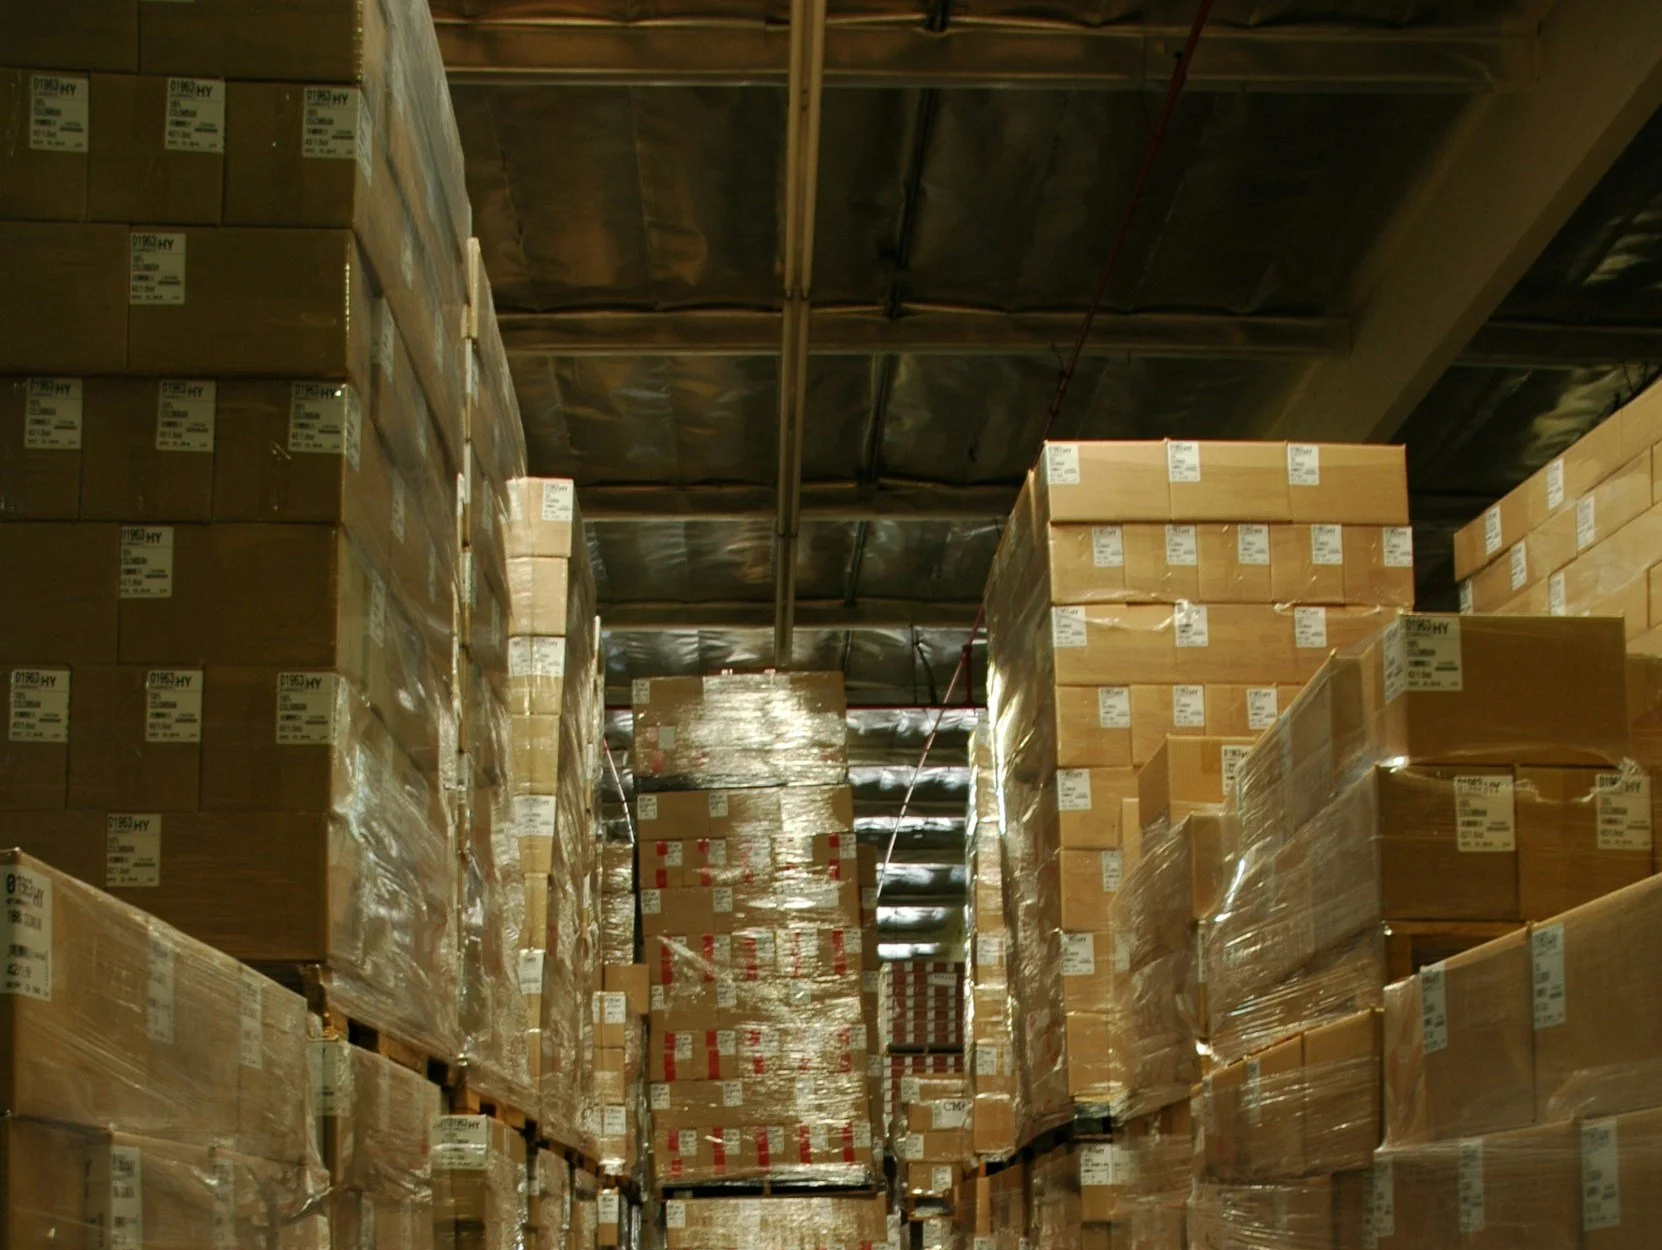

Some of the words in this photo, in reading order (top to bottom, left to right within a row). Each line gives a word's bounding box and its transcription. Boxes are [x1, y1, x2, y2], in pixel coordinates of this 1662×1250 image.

[60, 83, 77, 95] HY
[196, 86, 213, 97] HY
[332, 94, 350, 105] HY
[158, 239, 175, 250] HY
[55, 383, 72, 396] HY
[188, 386, 204, 398] HY
[145, 533, 162, 545] HY
[1433, 623, 1450, 635] HY
[15, 671, 40, 684] 01963
[41, 676, 57, 688] HY
[150, 672, 174, 684] 01963
[175, 676, 192, 688] HY
[280, 674, 305, 687] 01963
[306, 678, 322, 690] HY
[133, 820, 150, 831] HY
